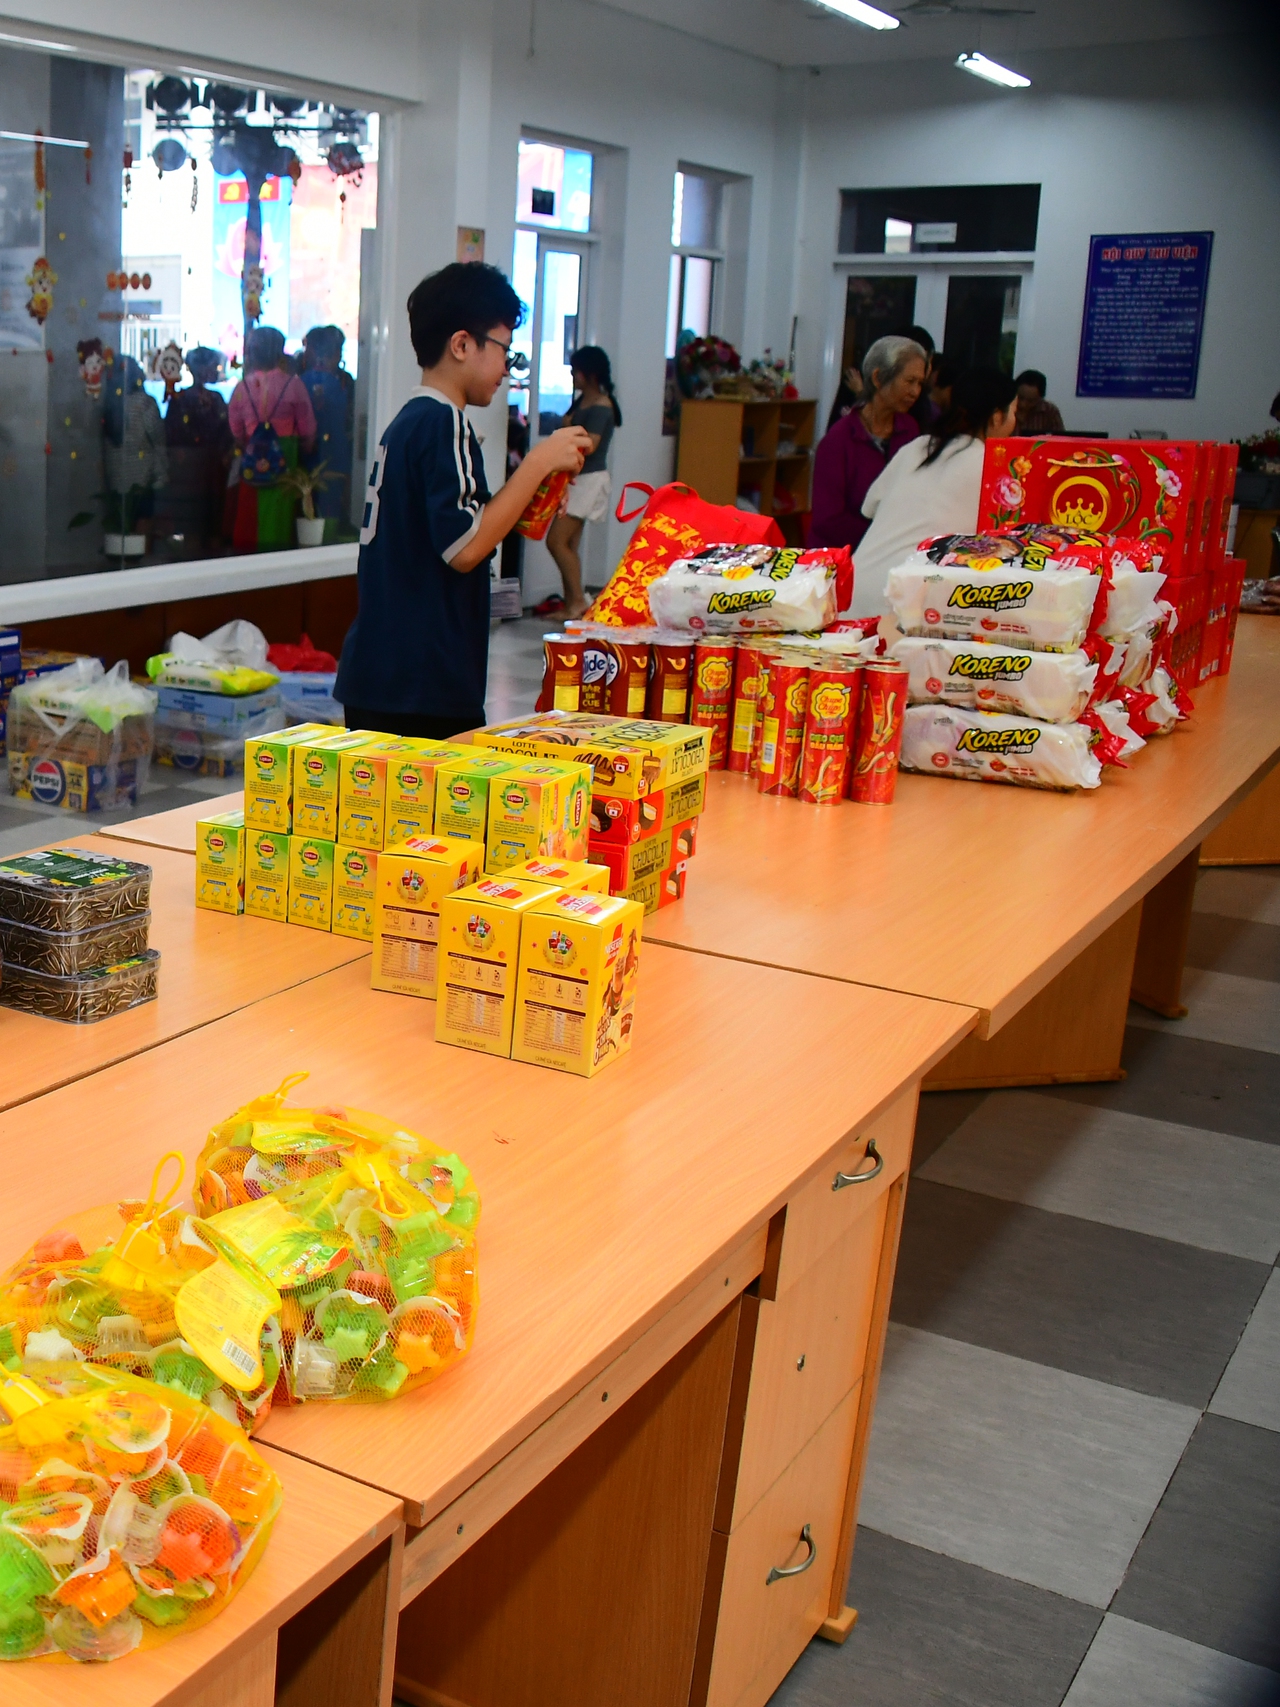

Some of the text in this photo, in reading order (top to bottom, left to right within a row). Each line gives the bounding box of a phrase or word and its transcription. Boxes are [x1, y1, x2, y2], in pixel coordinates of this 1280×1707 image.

[1102, 246, 1121, 262] NỘI
[1123, 247, 1147, 261] QUY
[1171, 244, 1199, 261] VIỆN
[1066, 511, 1092, 526] LỘC
[708, 589, 776, 614] KORENO
[947, 582, 1033, 608] KORENO
[949, 654, 1032, 676] KORENO
[582, 685, 601, 693] BAR
[512, 741, 537, 749] LOTTE
[956, 728, 1041, 752] KORENO
[33, 774, 59, 787] PEPSI
[454, 787, 469, 795] Lipton
[507, 795, 523, 803] Lipton
[632, 841, 668, 869] CHOCOLAT
